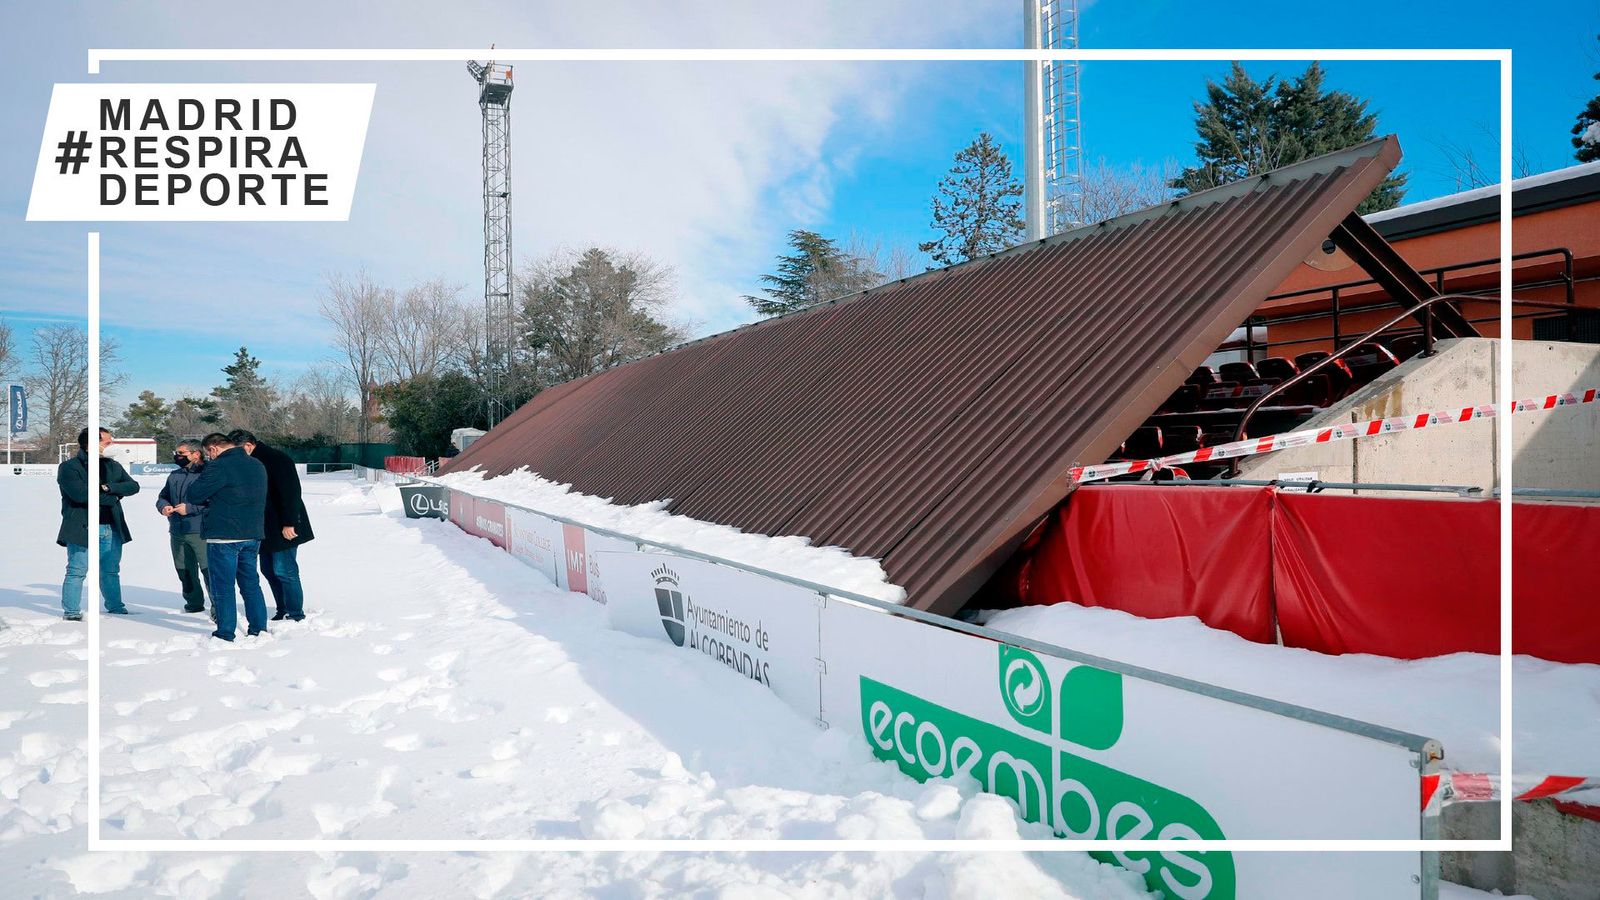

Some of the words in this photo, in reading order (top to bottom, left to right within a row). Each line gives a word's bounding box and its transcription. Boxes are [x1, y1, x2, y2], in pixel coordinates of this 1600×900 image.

[687, 595, 751, 644] Ayuntamiento
[755, 620, 769, 652] de
[869, 700, 1213, 900] ecoembes
